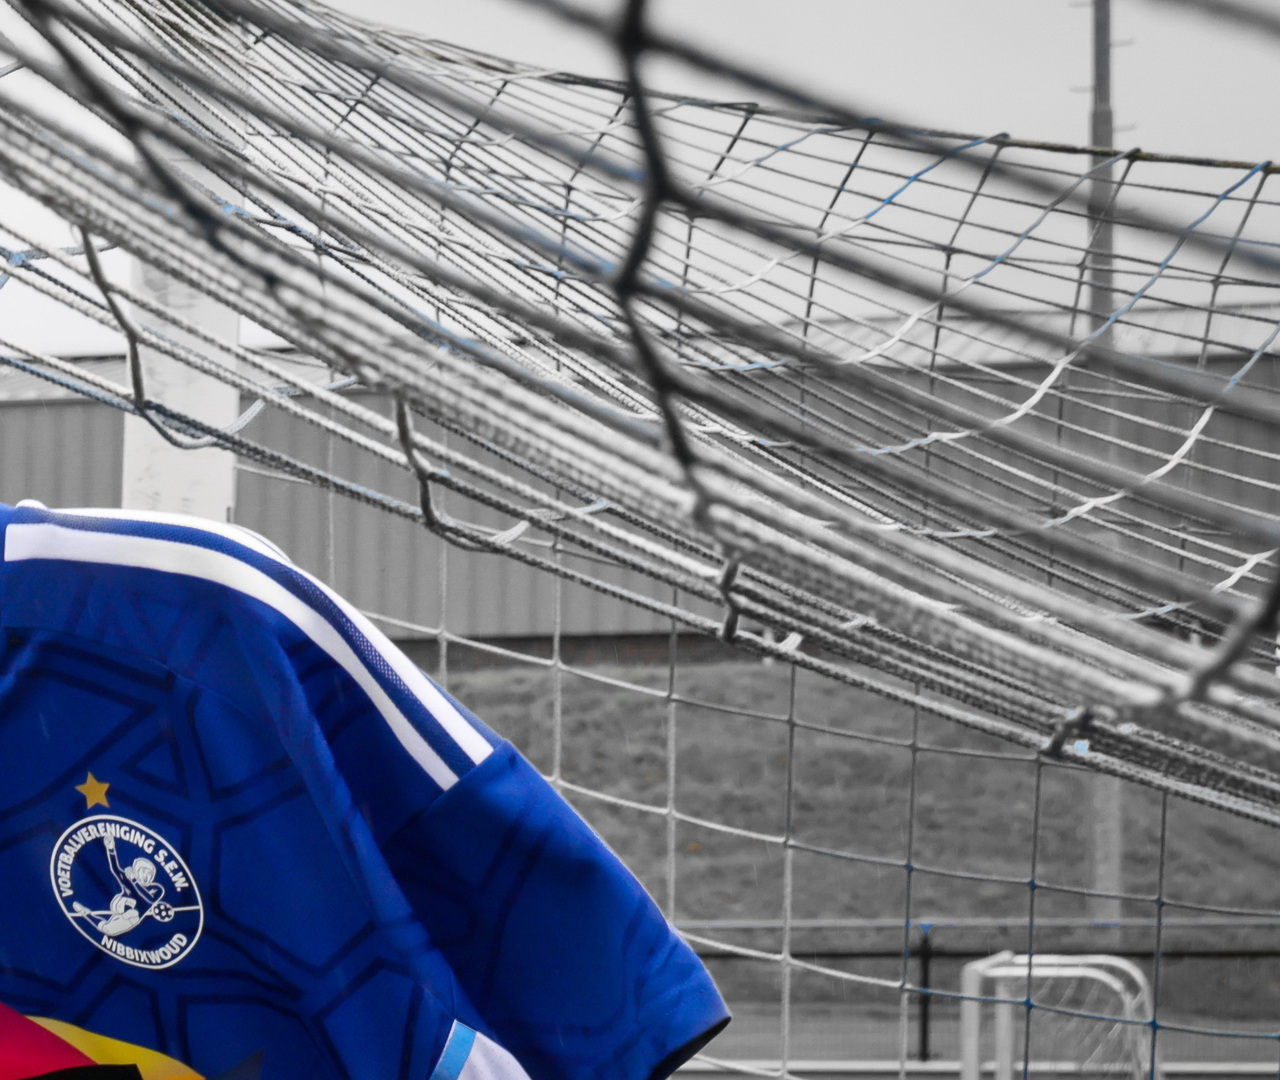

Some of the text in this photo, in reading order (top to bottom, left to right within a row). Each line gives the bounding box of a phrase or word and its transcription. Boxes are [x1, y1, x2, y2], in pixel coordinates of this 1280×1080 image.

[57, 822, 189, 897] VOETBALVERENIGING S.E.W.
[101, 933, 188, 964] NIBBIXWOUD
